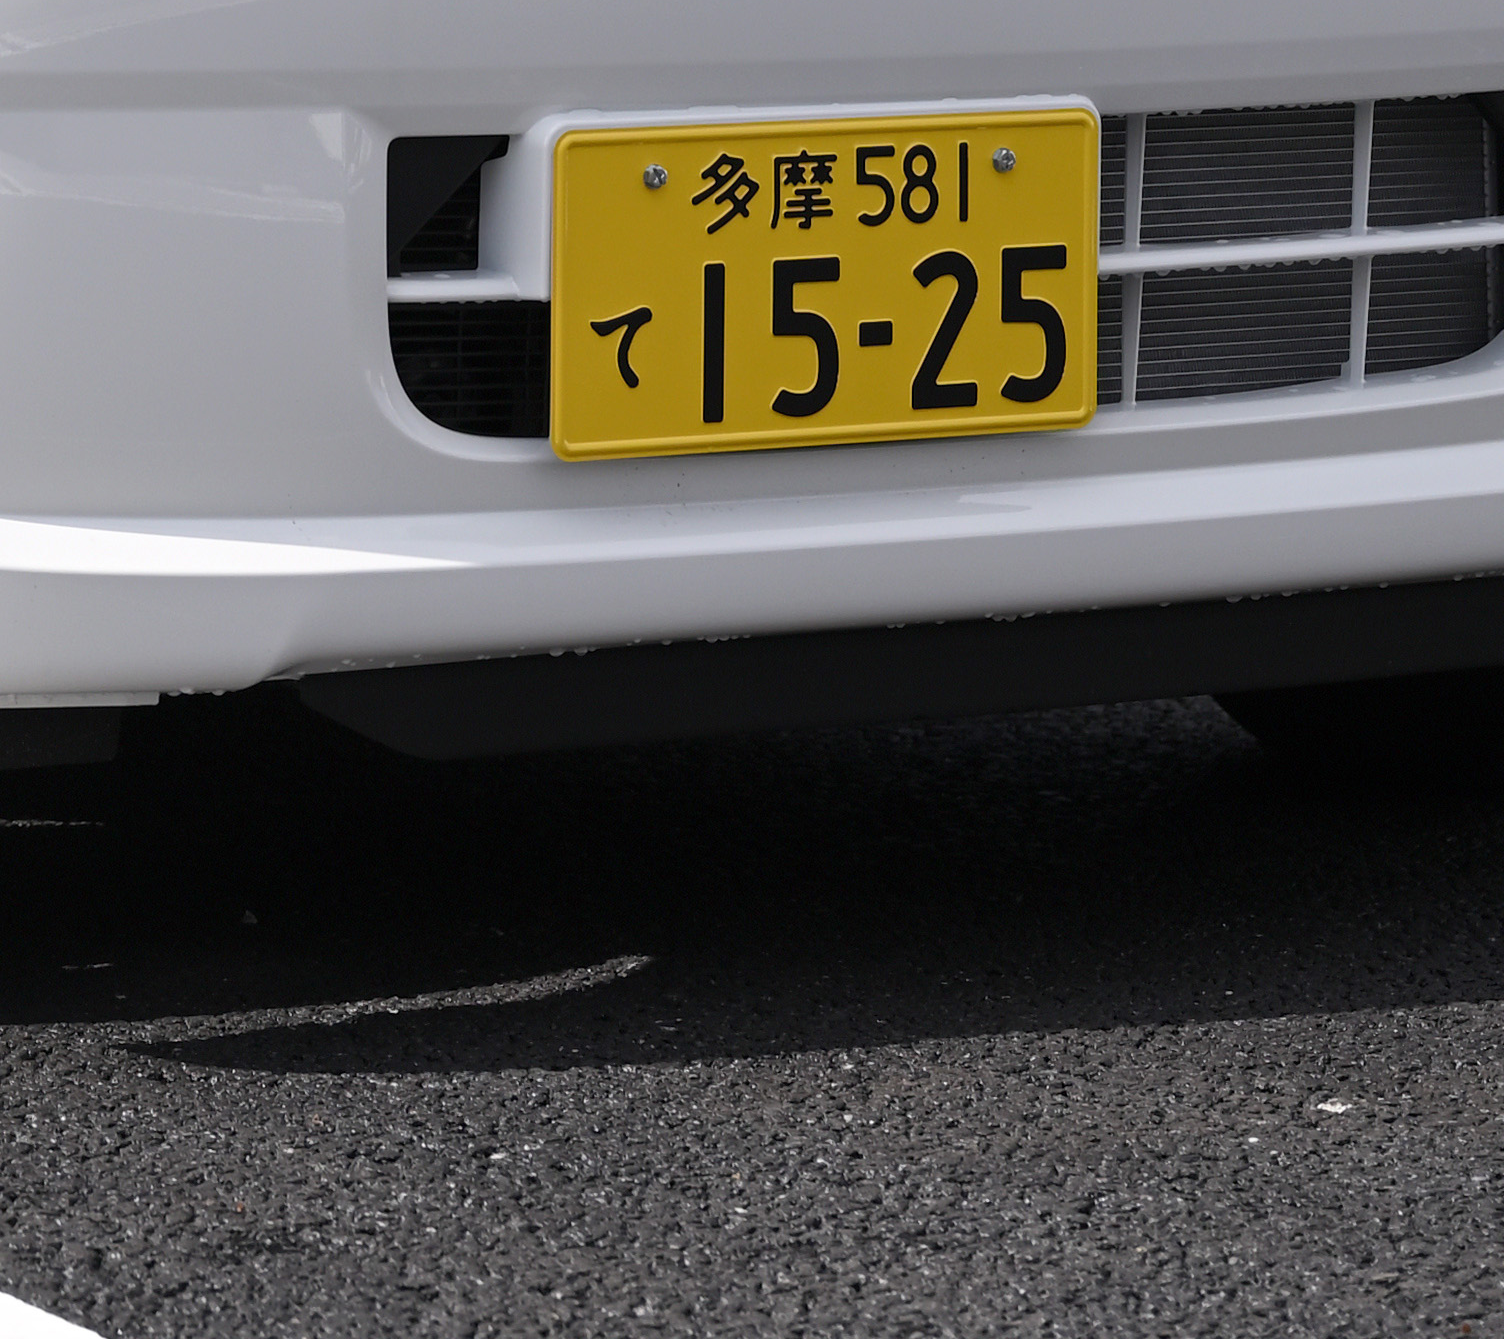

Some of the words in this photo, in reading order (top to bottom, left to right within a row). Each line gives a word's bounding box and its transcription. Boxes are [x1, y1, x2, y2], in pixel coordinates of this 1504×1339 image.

[691, 149, 838, 235] 多摩
[855, 141, 970, 227] 581
[590, 306, 653, 388] て
[701, 243, 1068, 424] 15-25
